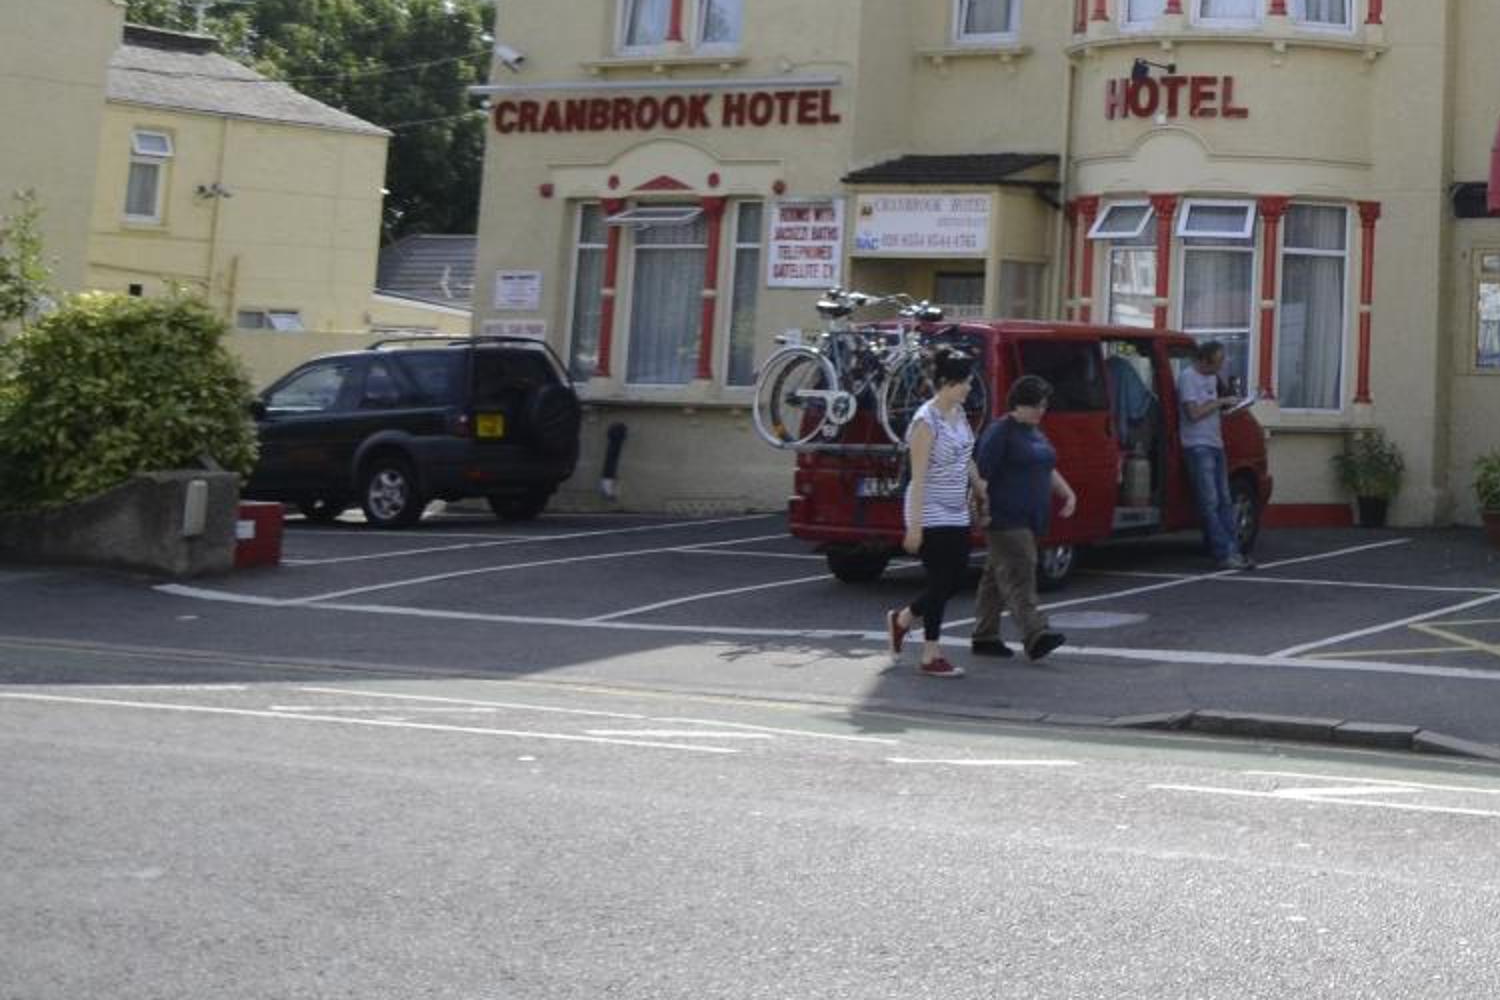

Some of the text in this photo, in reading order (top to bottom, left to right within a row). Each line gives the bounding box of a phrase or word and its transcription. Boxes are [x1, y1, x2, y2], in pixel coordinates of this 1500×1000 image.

[494, 90, 841, 134] CRANBROOK HOTEL
[1105, 75, 1249, 120] HOTEL
